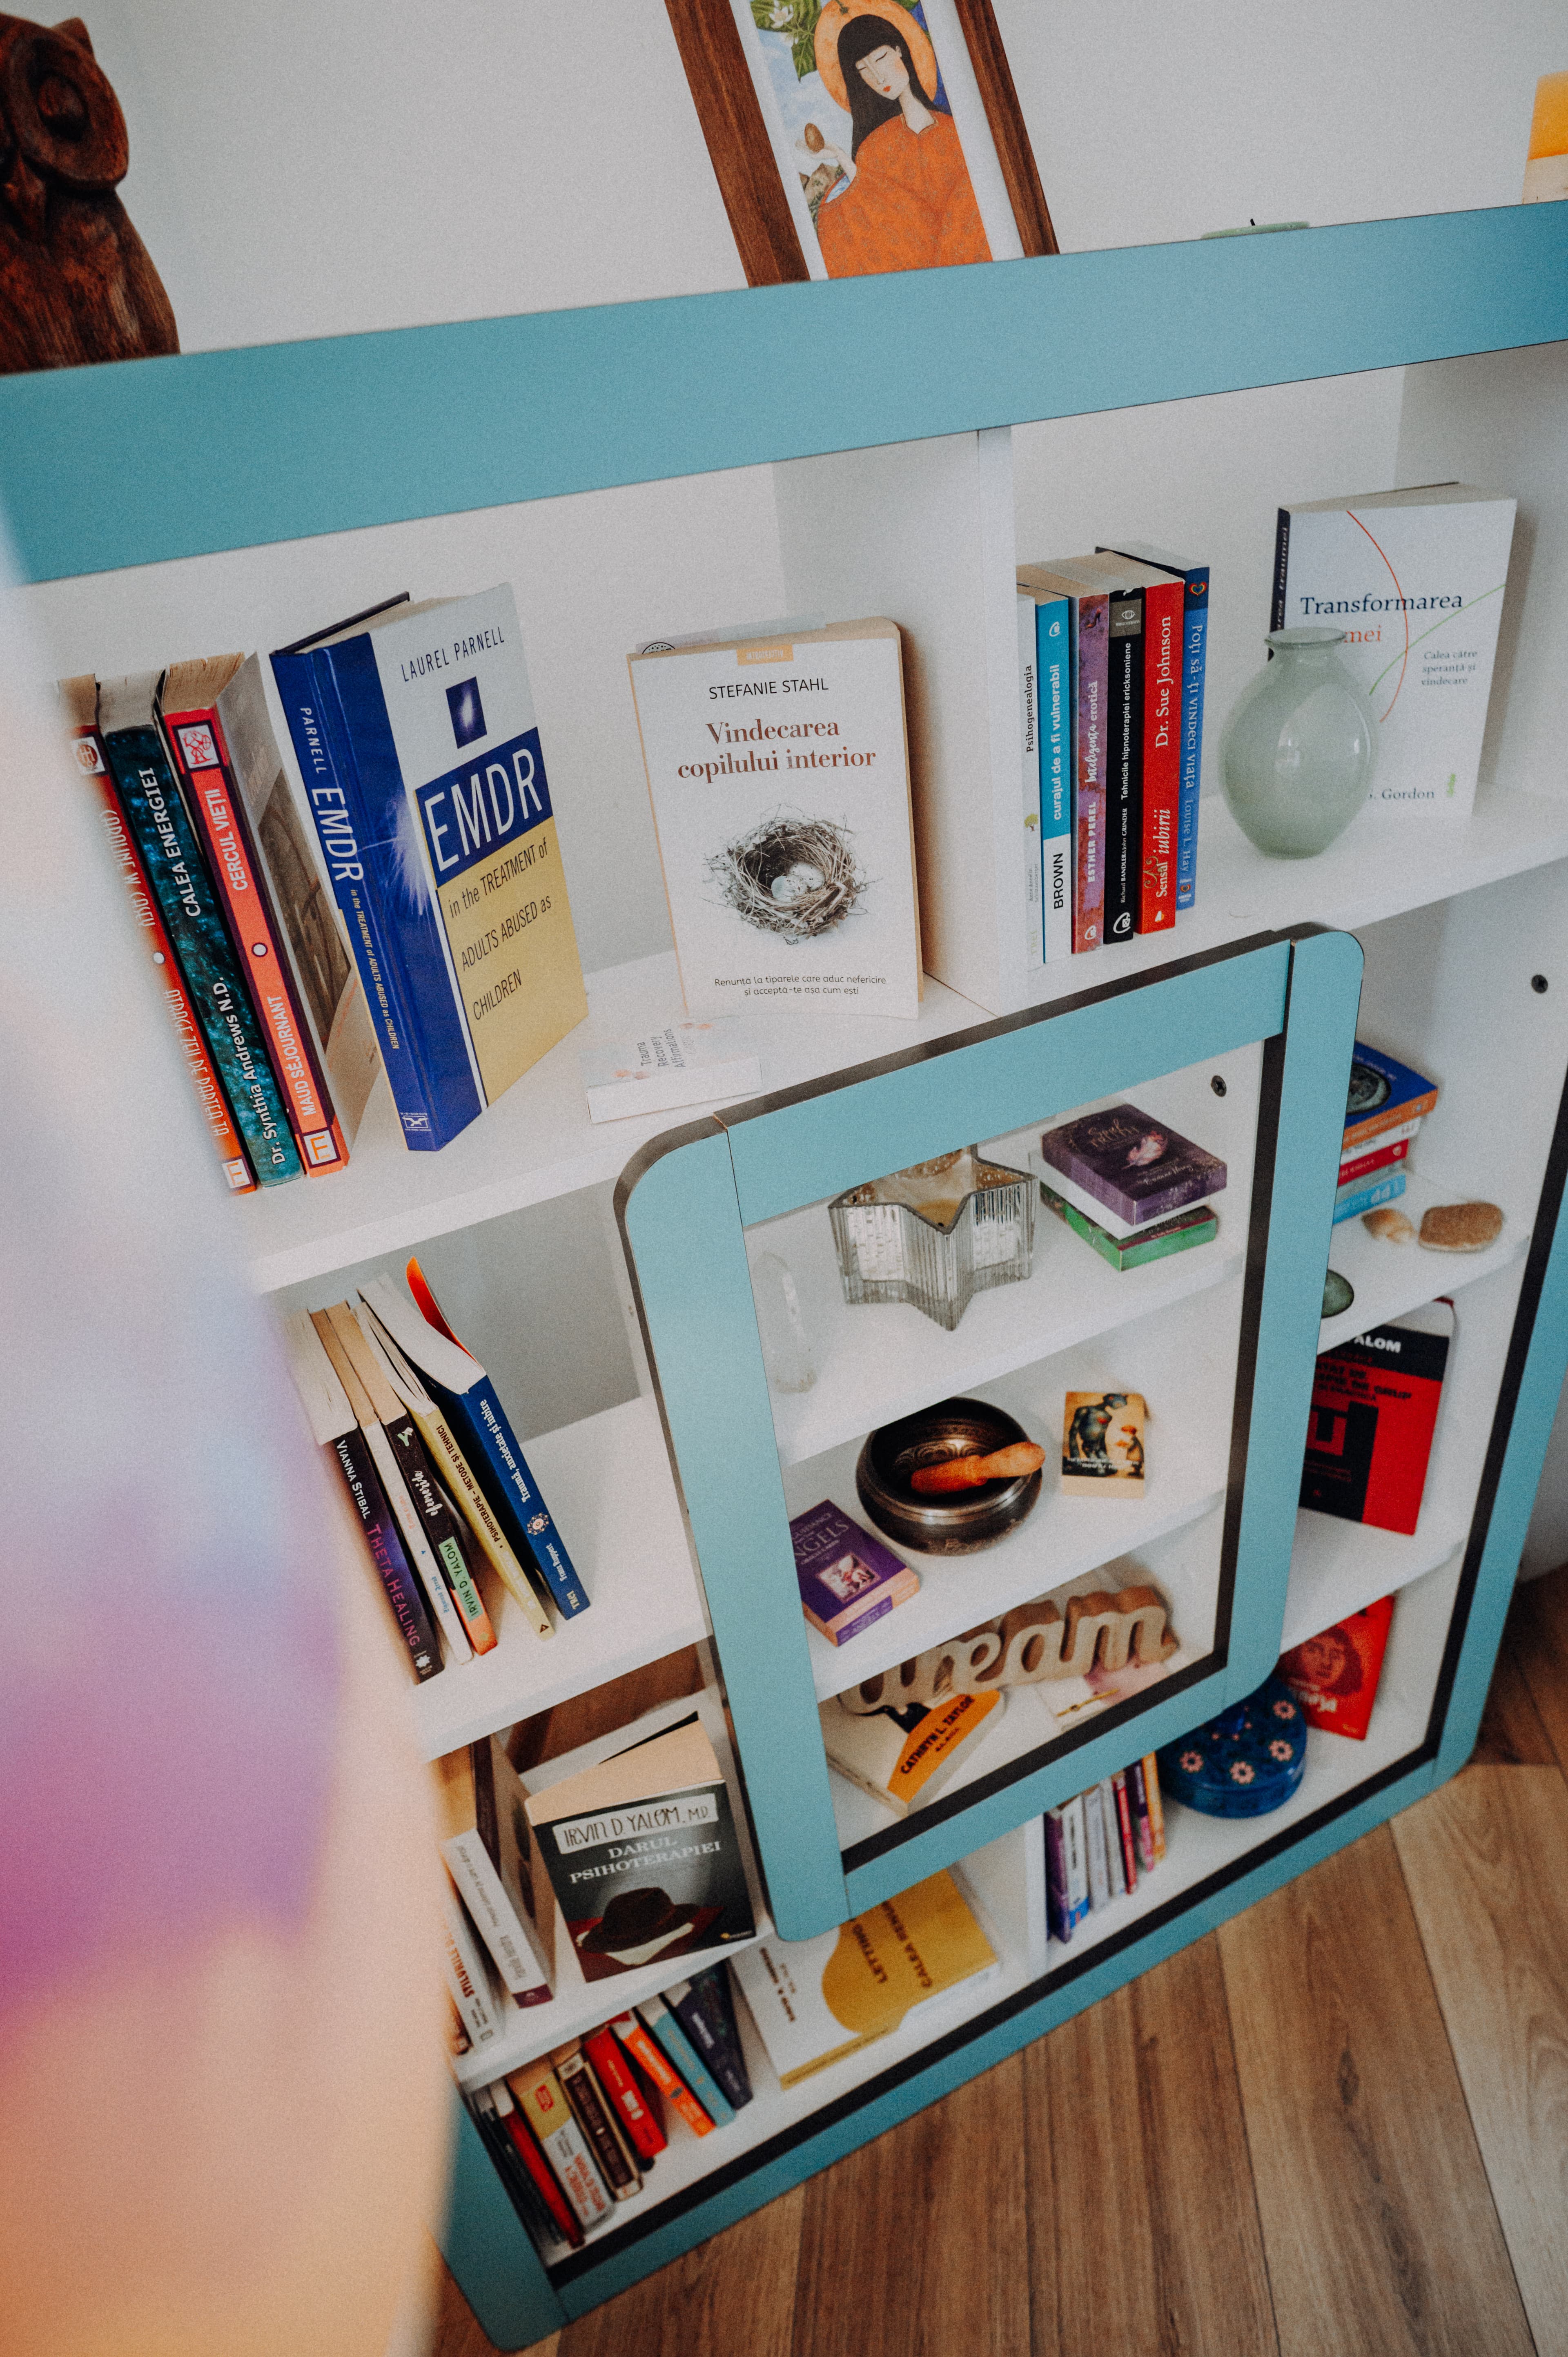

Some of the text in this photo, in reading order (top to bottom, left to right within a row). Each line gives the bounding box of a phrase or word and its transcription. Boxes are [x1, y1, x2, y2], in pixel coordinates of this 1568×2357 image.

[1300, 593, 1463, 615] Transformarea
[401, 626, 505, 682] LAUREL PARNELL
[709, 678, 829, 700] STEFANIE STAHL
[1088, 680, 1098, 721] erotică
[1156, 616, 1174, 748] Dr. Sue Johnson
[705, 719, 840, 745] Vindecarea
[1050, 665, 1064, 821] curajul de a fi vulnerabil
[1122, 703, 1131, 760] hipnoterapiei
[678, 746, 876, 783] copilului interior
[300, 707, 364, 881] PARNELL EMDR
[425, 749, 542, 872] EMDR
[1382, 787, 1434, 799] Gordon
[1153, 809, 1170, 854] iubirii
[1184, 799, 1193, 834] Louise
[138, 768, 202, 916] CALEA ENERGIEI
[1087, 802, 1096, 882] ESTHER PEREL
[1181, 850, 1191, 871] Hay
[219, 835, 248, 891] CERCUL
[449, 838, 548, 918] in the TREATMENT of
[1054, 853, 1063, 909] BROWN
[352, 898, 361, 909] the
[356, 911, 372, 948] TREATMENT
[461, 895, 552, 971] ADULTS ABUSED as
[369, 957, 381, 981] ADULTS
[765, 974, 799, 984] tiparele
[847, 976, 886, 984] nefericire
[164, 989, 193, 1034] ATRAGE
[376, 982, 388, 1008] ABUSED
[472, 968, 522, 1020] CHILDREN
[385, 1019, 399, 1049] CHILDREN
[637, 1042, 652, 1066] Trauma
[650, 1036, 669, 1067] Recovery
[663, 1029, 686, 1067] Affirmations
[187, 1061, 208, 1075] DE
[213, 977, 286, 1164] Dr. Synthia Andrews N.D.
[267, 996, 316, 1115] MAUD SÉJOURNANT
[194, 1077, 223, 1119] PARTEA
[1352, 1335, 1401, 1353] ALOM
[480, 1399, 496, 1424] iubire
[436, 1425, 458, 1450] TEHNICI
[492, 1429, 517, 1470] anxietate
[336, 1440, 371, 1519] VIANNA STIBAL
[455, 1461, 474, 1490] METODE
[510, 1468, 531, 1503] Traumă,
[472, 1495, 499, 1543] PSIHOTERAPIE
[444, 1542, 479, 1616] IRVIN D. YALOM
[546, 1543, 567, 1581] Franz Ruppert
[368, 1524, 420, 1646] THETA HEALING
[901, 1733, 938, 1774] CATHRYN
[564, 1822, 608, 1847] IRVIN
[607, 1837, 677, 1859] DARUL
[570, 1841, 720, 1884] PSIHOTERAPIEI
